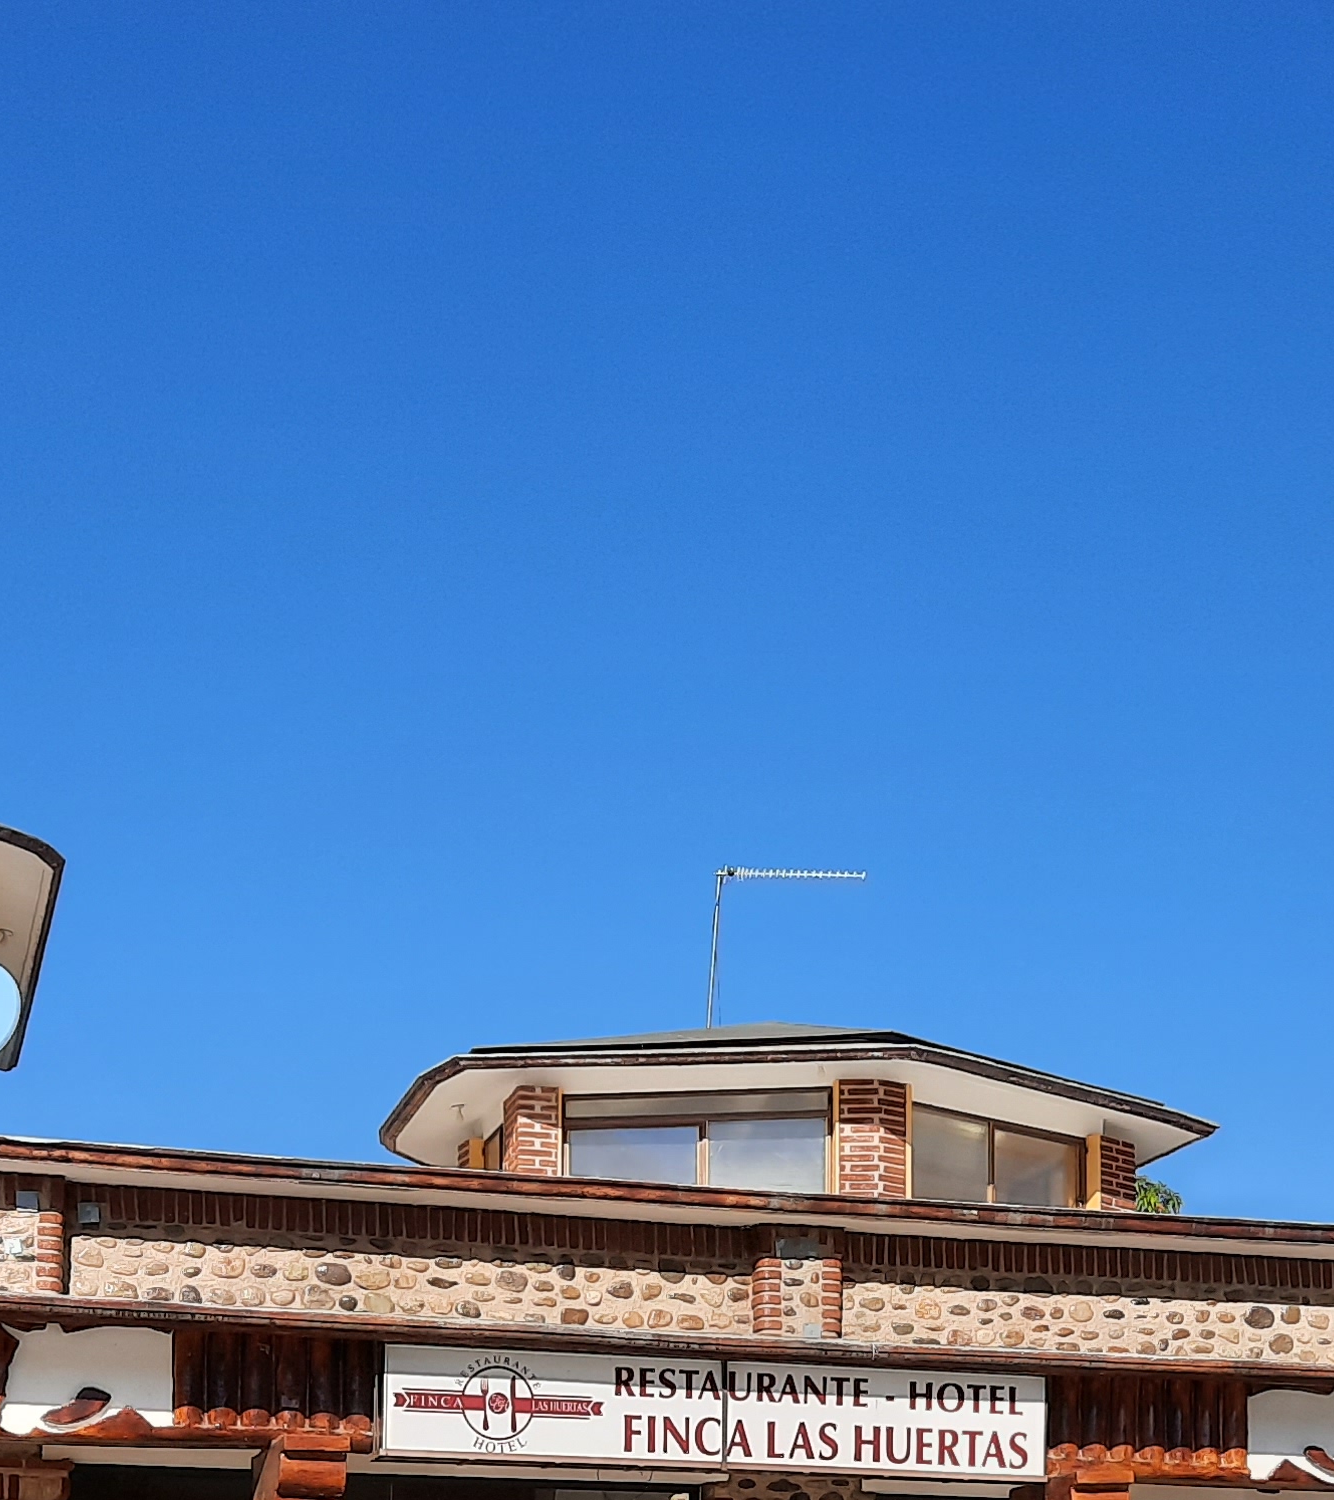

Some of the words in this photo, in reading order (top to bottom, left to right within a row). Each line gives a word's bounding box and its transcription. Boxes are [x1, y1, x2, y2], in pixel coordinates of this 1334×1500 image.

[615, 1366, 870, 1408] RESTAURANTE
[909, 1381, 1024, 1416] HOTEL
[410, 1395, 464, 1411] FINCA
[532, 1400, 549, 1412] LAS
[550, 1401, 589, 1414] HUERTAS
[472, 1436, 529, 1454] HOTEL
[623, 1414, 752, 1458] FINCA
[767, 1421, 839, 1461] LAS
[853, 1424, 1029, 1470] HUERTAS
